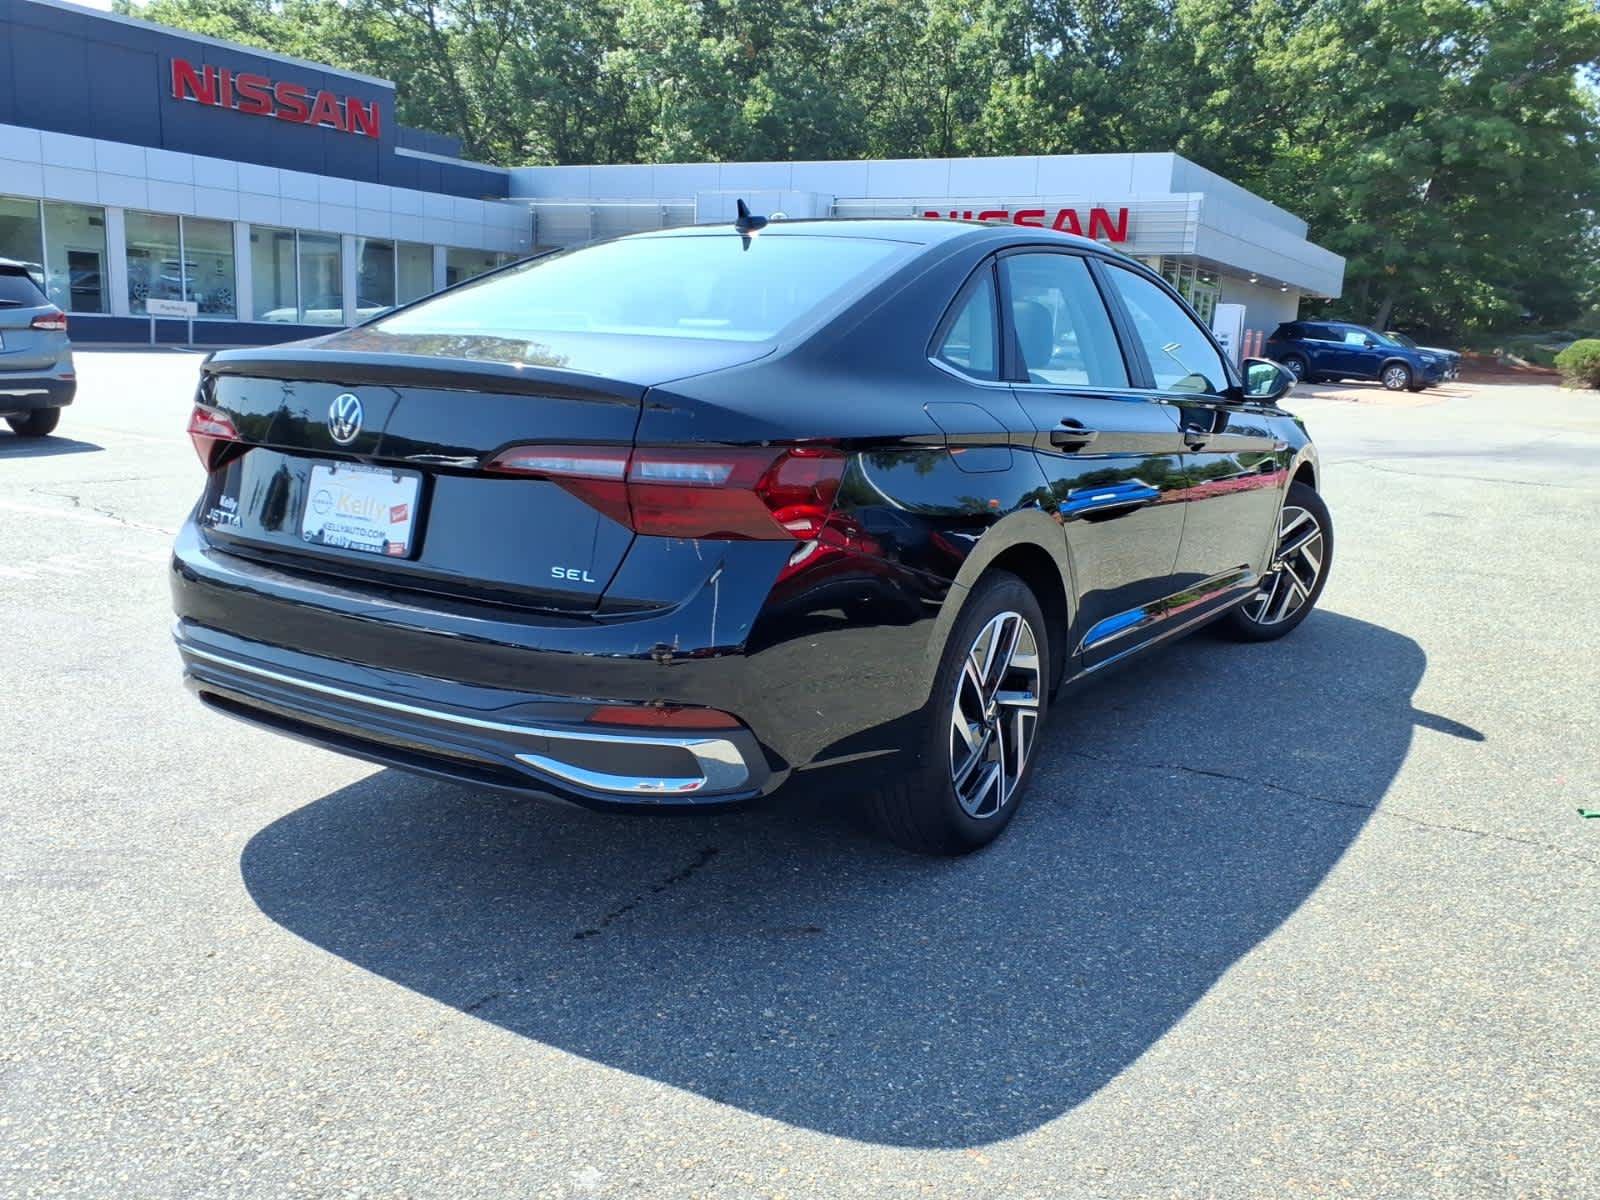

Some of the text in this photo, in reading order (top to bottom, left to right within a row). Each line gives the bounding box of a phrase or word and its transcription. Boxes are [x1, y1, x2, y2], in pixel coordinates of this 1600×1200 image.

[171, 57, 380, 138] NISSAN
[924, 207, 1128, 242] SAN
[336, 493, 386, 520] Kelly
[323, 532, 351, 550] Kelly
[551, 566, 596, 583] SEL
